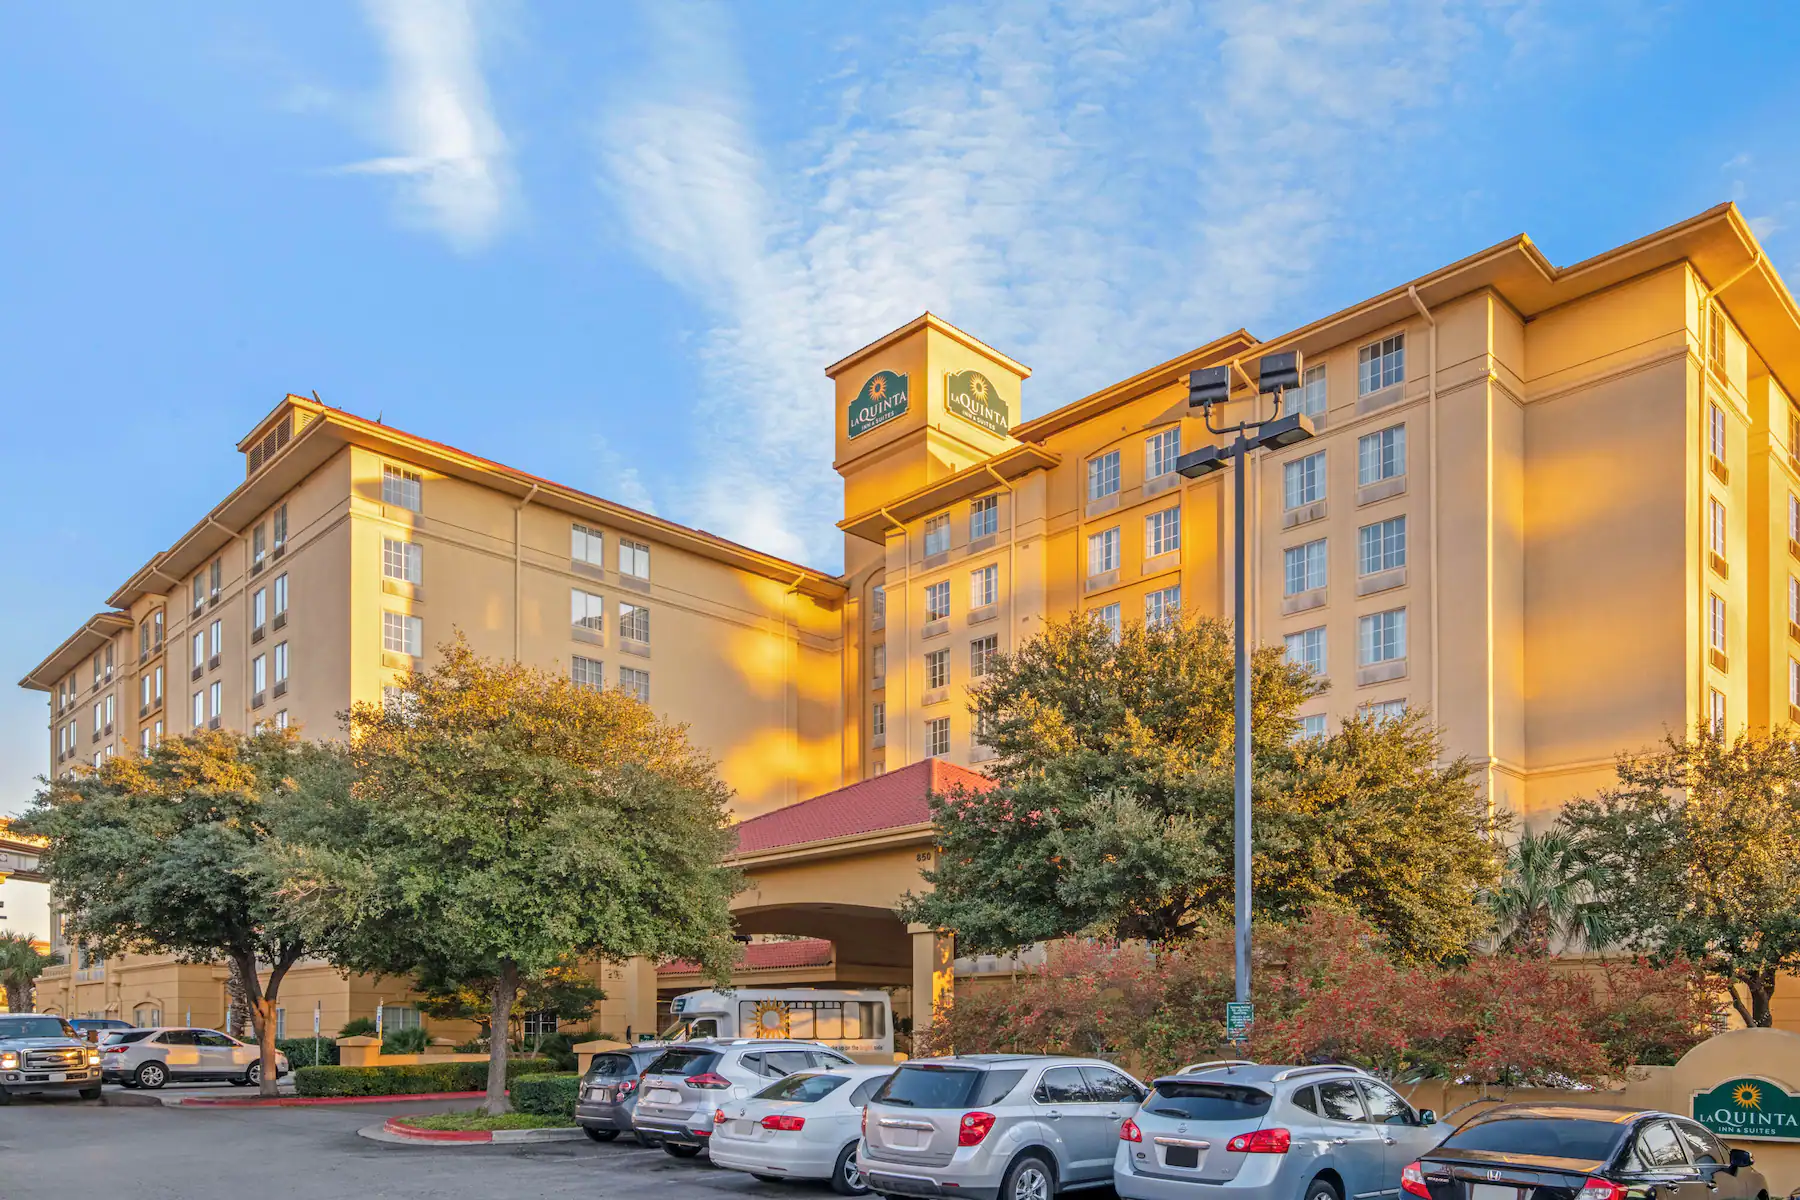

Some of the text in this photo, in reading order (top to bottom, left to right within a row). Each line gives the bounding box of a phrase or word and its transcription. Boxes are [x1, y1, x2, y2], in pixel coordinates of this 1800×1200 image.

[851, 391, 907, 428] LA QUINTA
[875, 410, 895, 424] SUITES
[951, 393, 1008, 428] LA QUINTA
[976, 416, 996, 431] SUITES
[916, 851, 932, 862] 850
[1700, 1108, 1798, 1127] LA QUINTA
[1743, 1127, 1776, 1135] SUITES
